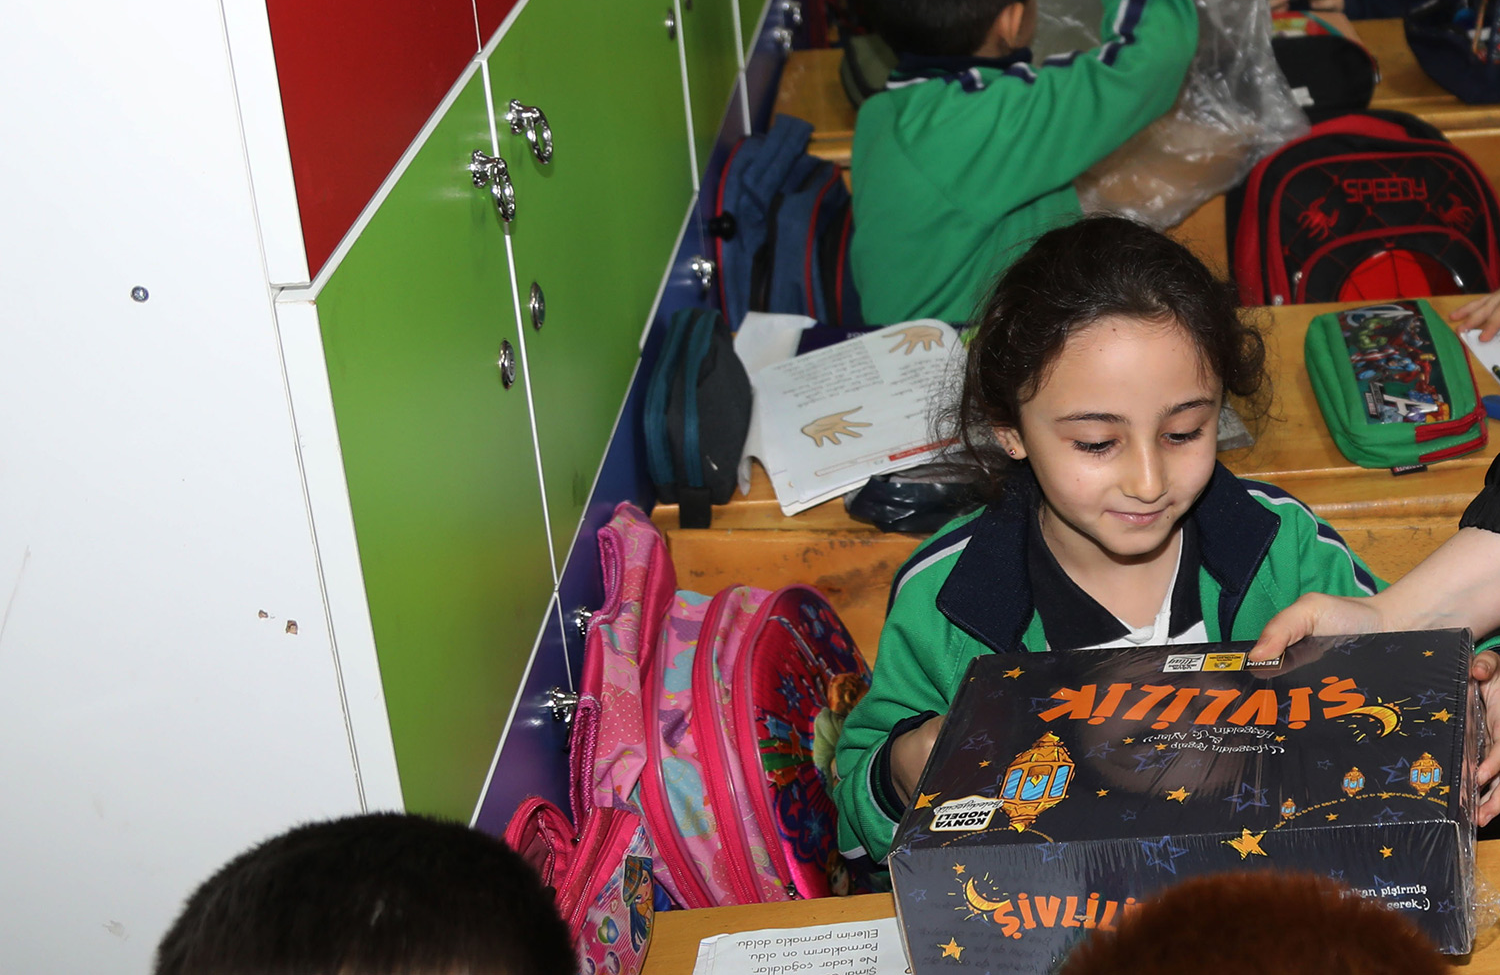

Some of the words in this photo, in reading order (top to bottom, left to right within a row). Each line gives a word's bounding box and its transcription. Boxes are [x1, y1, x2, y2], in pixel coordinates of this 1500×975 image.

[1341, 176, 1429, 203] SPEEDY
[1037, 675, 1366, 731] ŞİVLİLİK
[935, 817, 987, 829] KONYA
[775, 931, 833, 947] parmakla
[836, 928, 879, 940] Ellerim
[735, 939, 772, 950] doldu.
[803, 942, 879, 957] Parmaklarım
[748, 952, 777, 962] oldu.
[781, 950, 798, 959] on
[858, 955, 878, 965] Ne
[751, 961, 814, 975] çoğaldılar.
[818, 957, 854, 969] kadar
